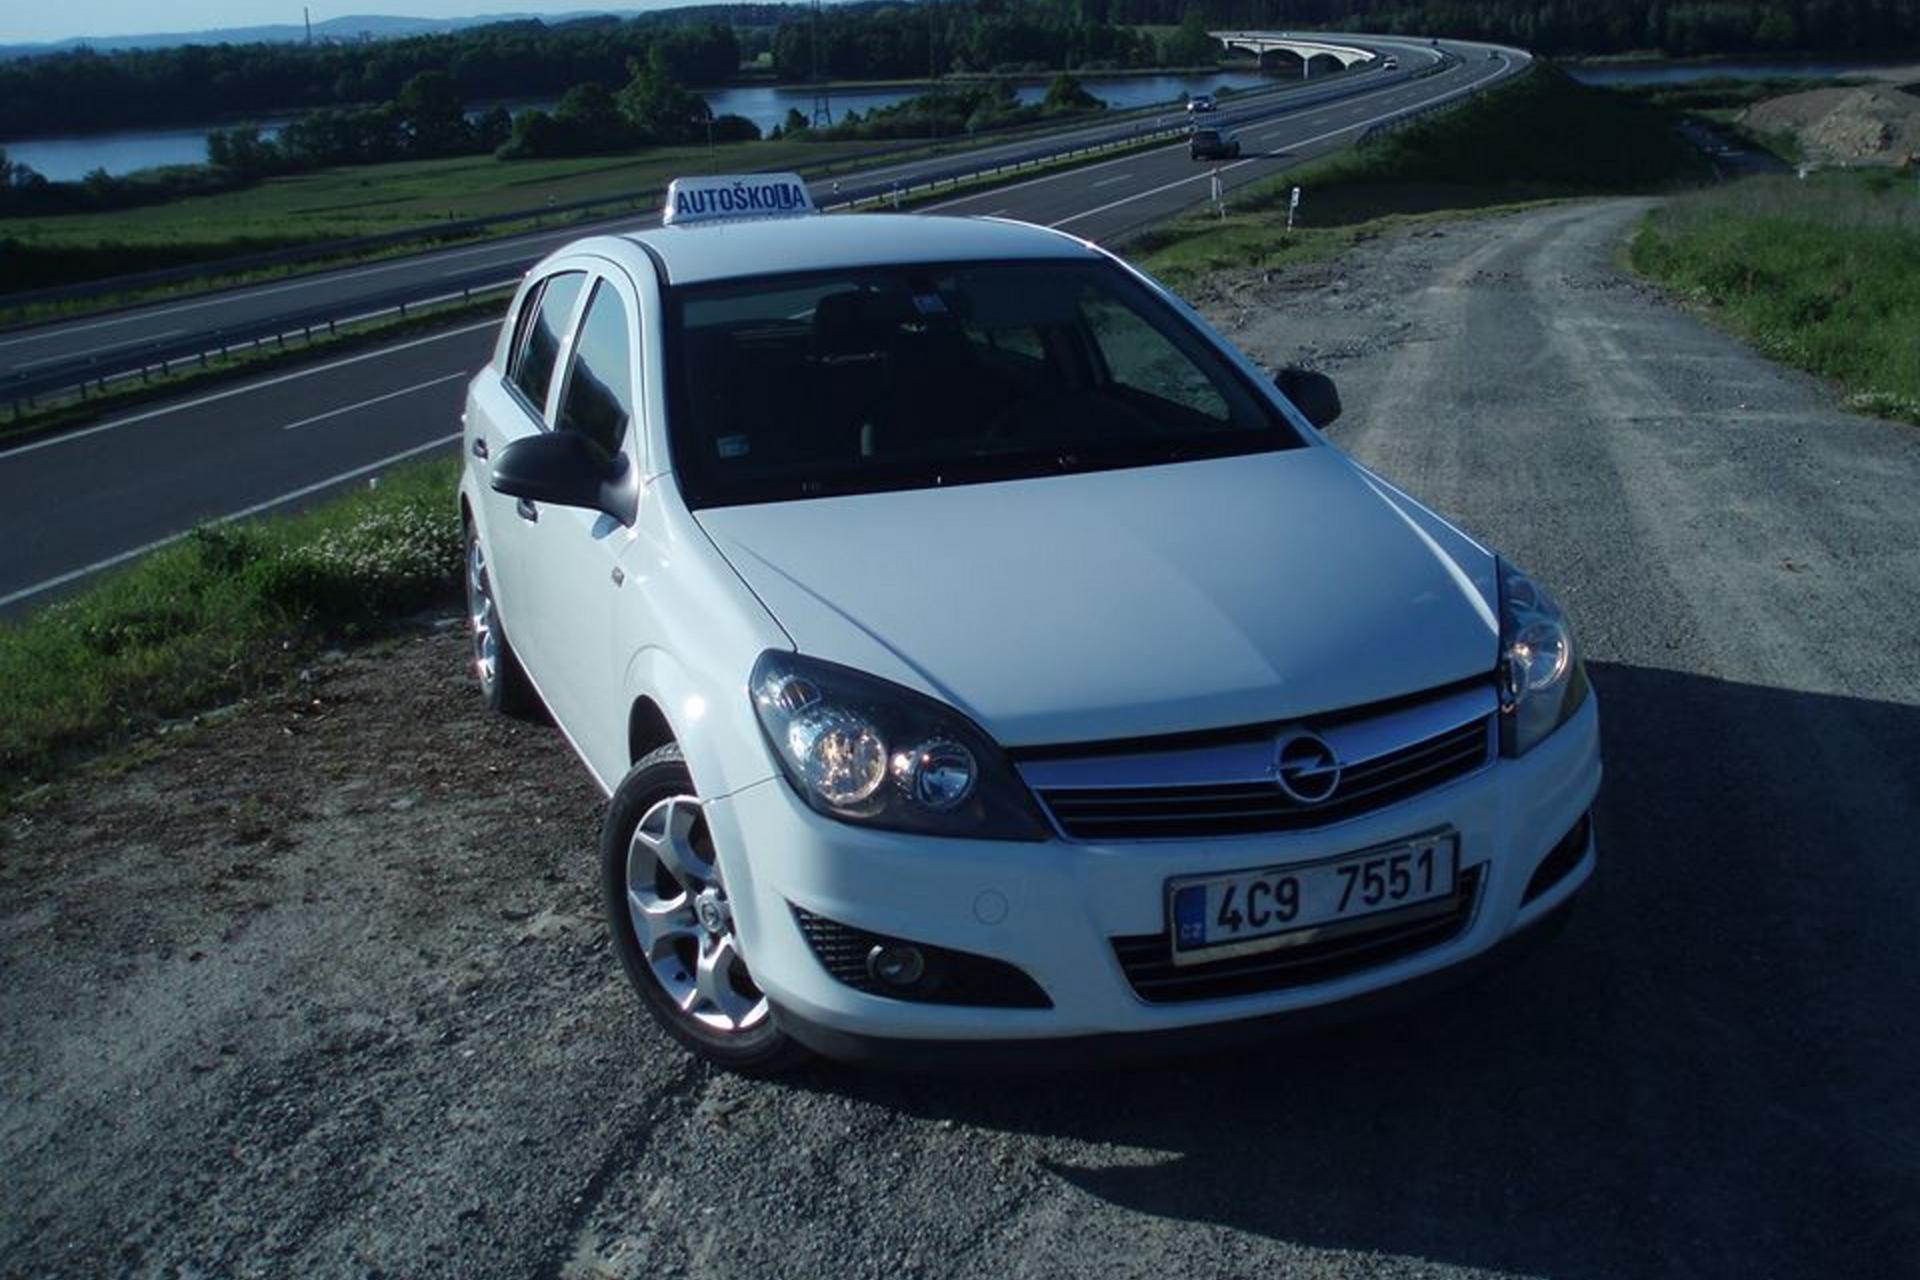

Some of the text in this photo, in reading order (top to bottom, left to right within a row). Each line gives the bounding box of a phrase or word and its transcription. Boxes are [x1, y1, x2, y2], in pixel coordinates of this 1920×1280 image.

[677, 181, 806, 214] AUTOŠKOLA
[1217, 849, 1434, 932] 4C9 7551
